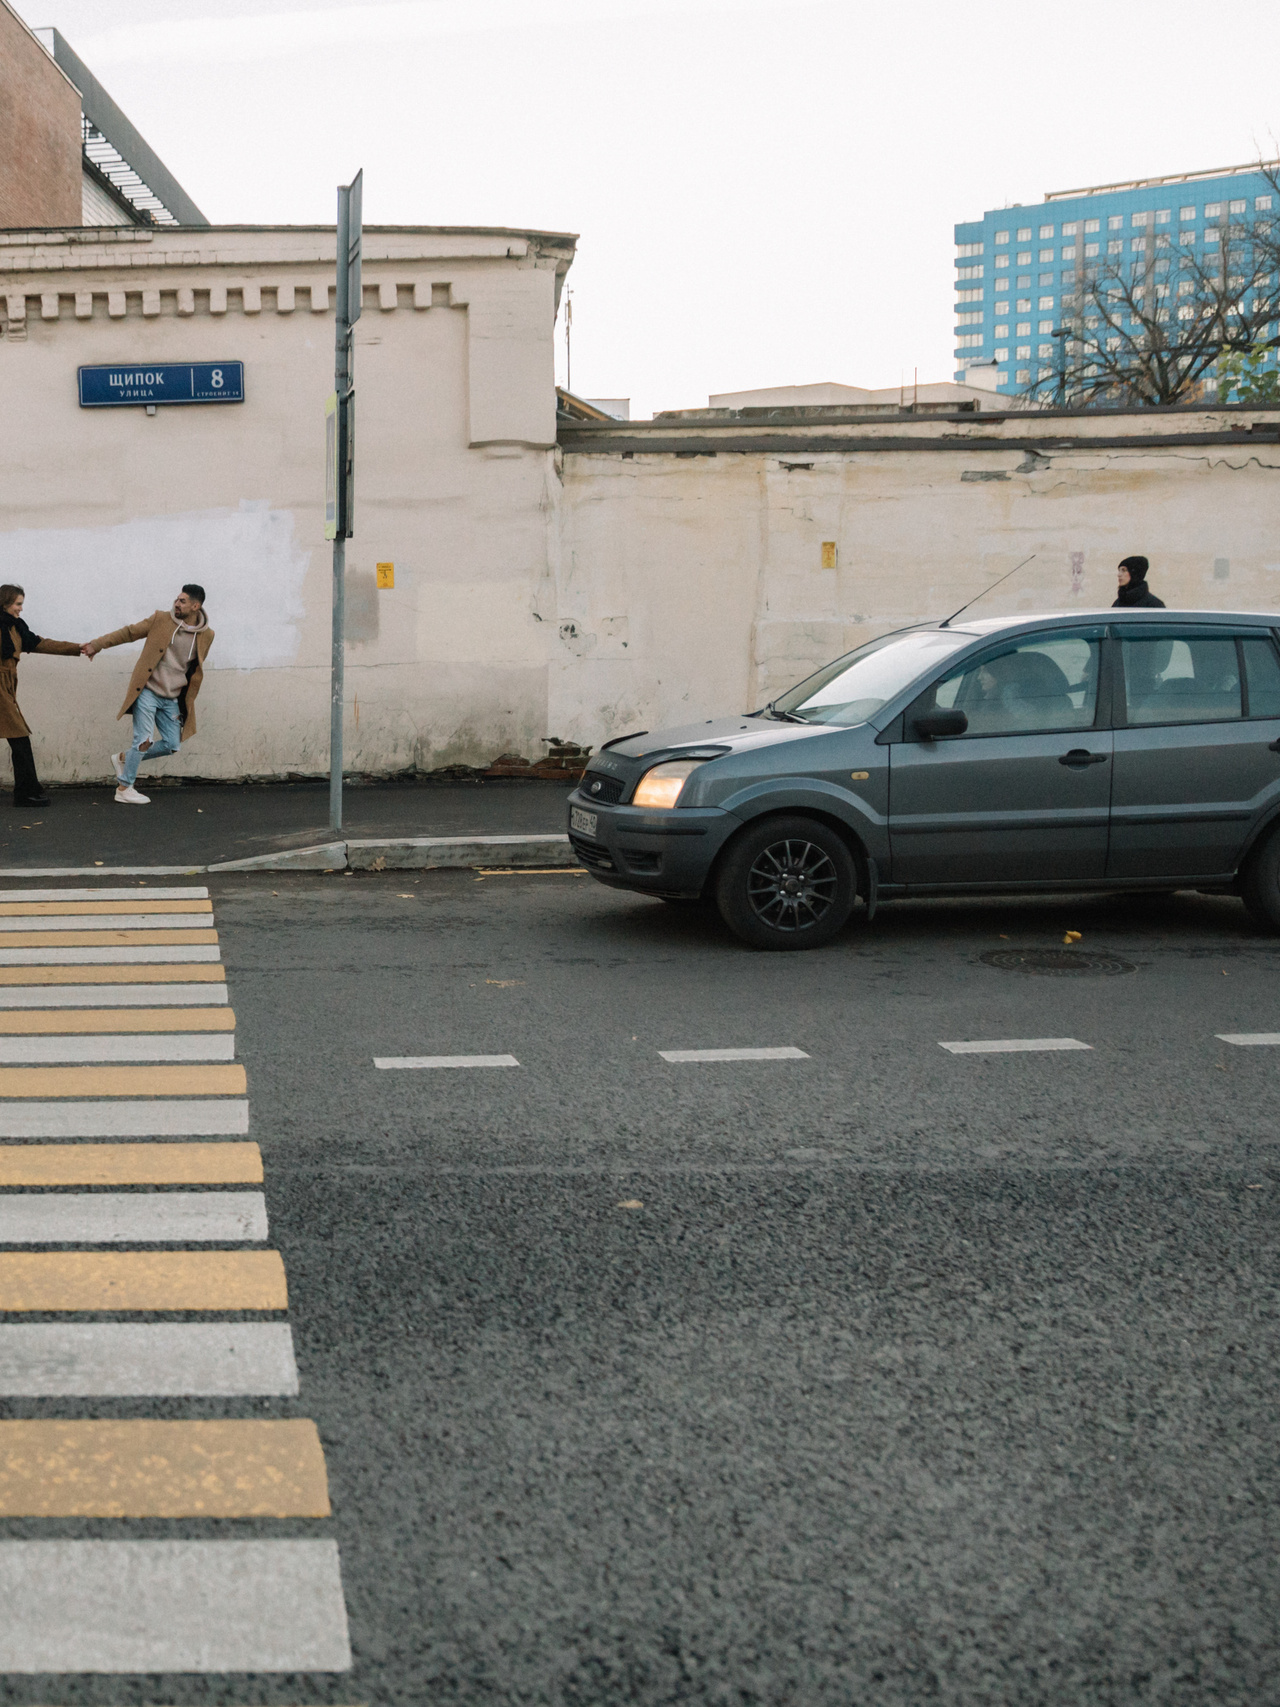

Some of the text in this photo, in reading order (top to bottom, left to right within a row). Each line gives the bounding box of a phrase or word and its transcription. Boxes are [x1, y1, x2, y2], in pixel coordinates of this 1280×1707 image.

[109, 373, 164, 387] ЩИПОК
[211, 369, 224, 388] 8
[120, 389, 154, 397] УЛИЦА
